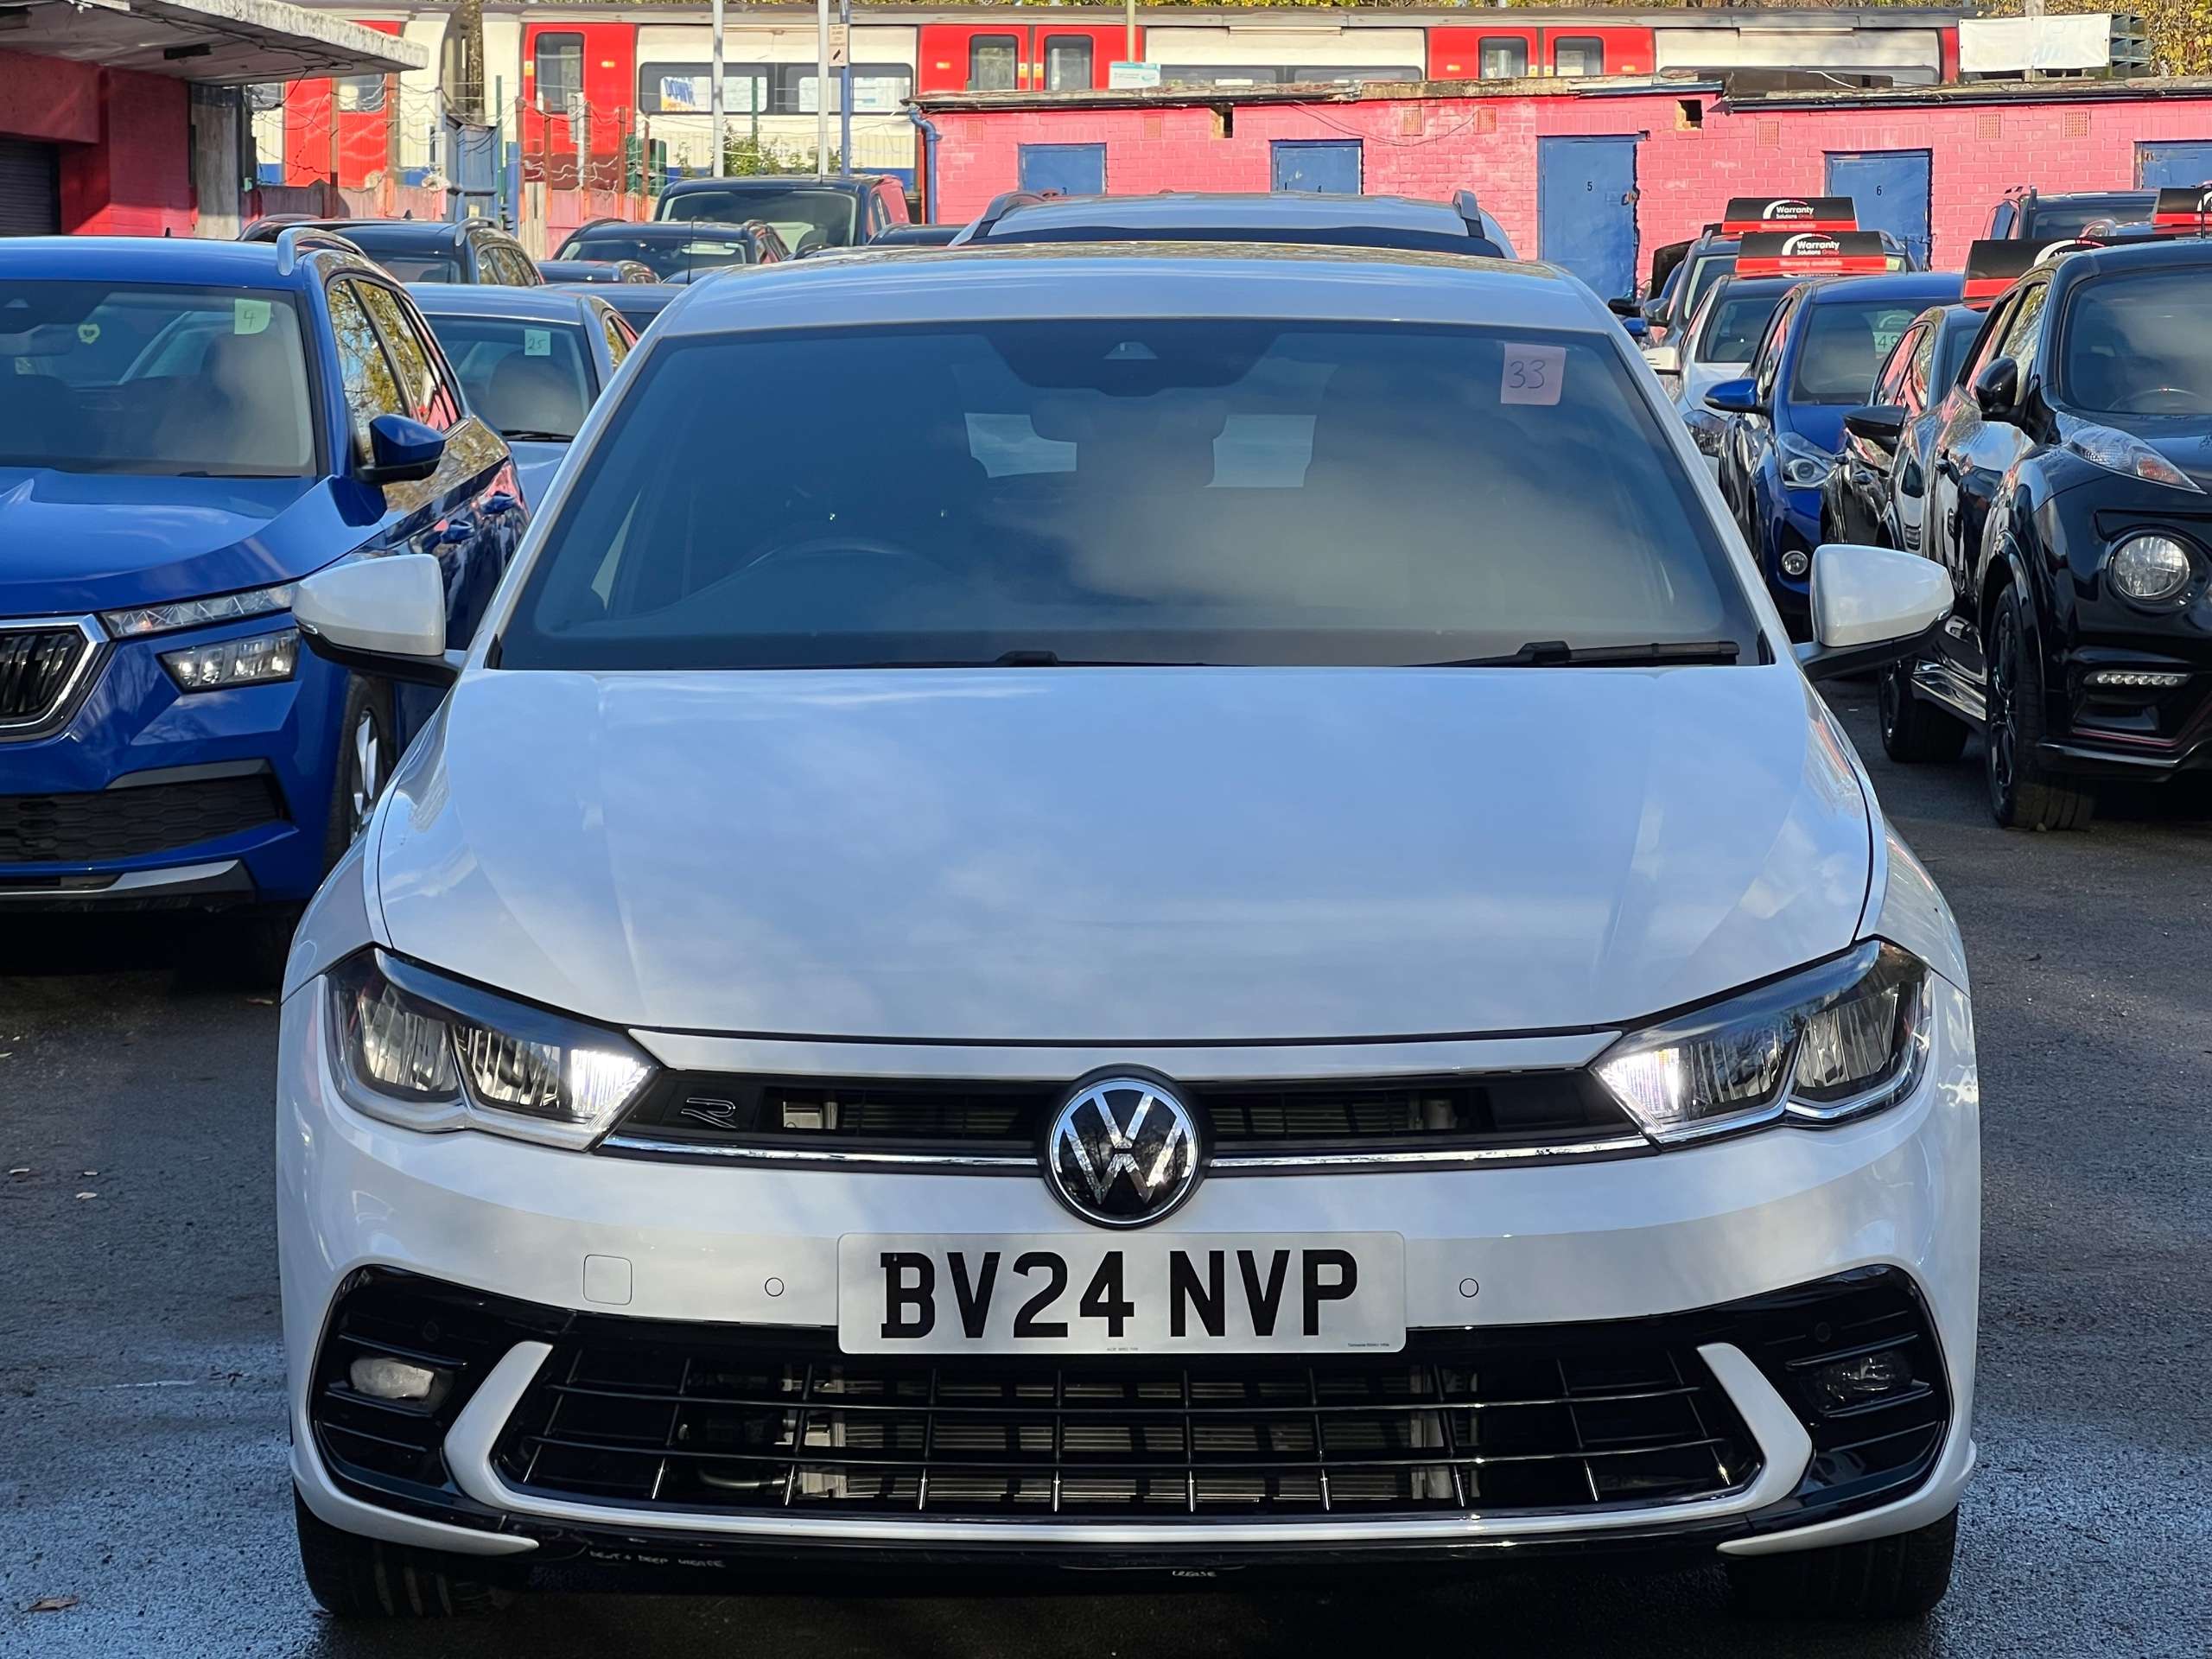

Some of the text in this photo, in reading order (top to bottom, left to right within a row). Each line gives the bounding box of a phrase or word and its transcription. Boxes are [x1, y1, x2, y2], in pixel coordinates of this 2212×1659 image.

[1587, 181, 1592, 191] 5
[1876, 185, 1882, 196] 6
[1776, 206, 1815, 215] Warranty
[1796, 240, 1840, 251] Warranty
[243, 310, 257, 328] 4
[528, 338, 547, 351] 25
[1509, 359, 1546, 389] 33
[880, 1249, 1358, 1338] BV24 NVP
